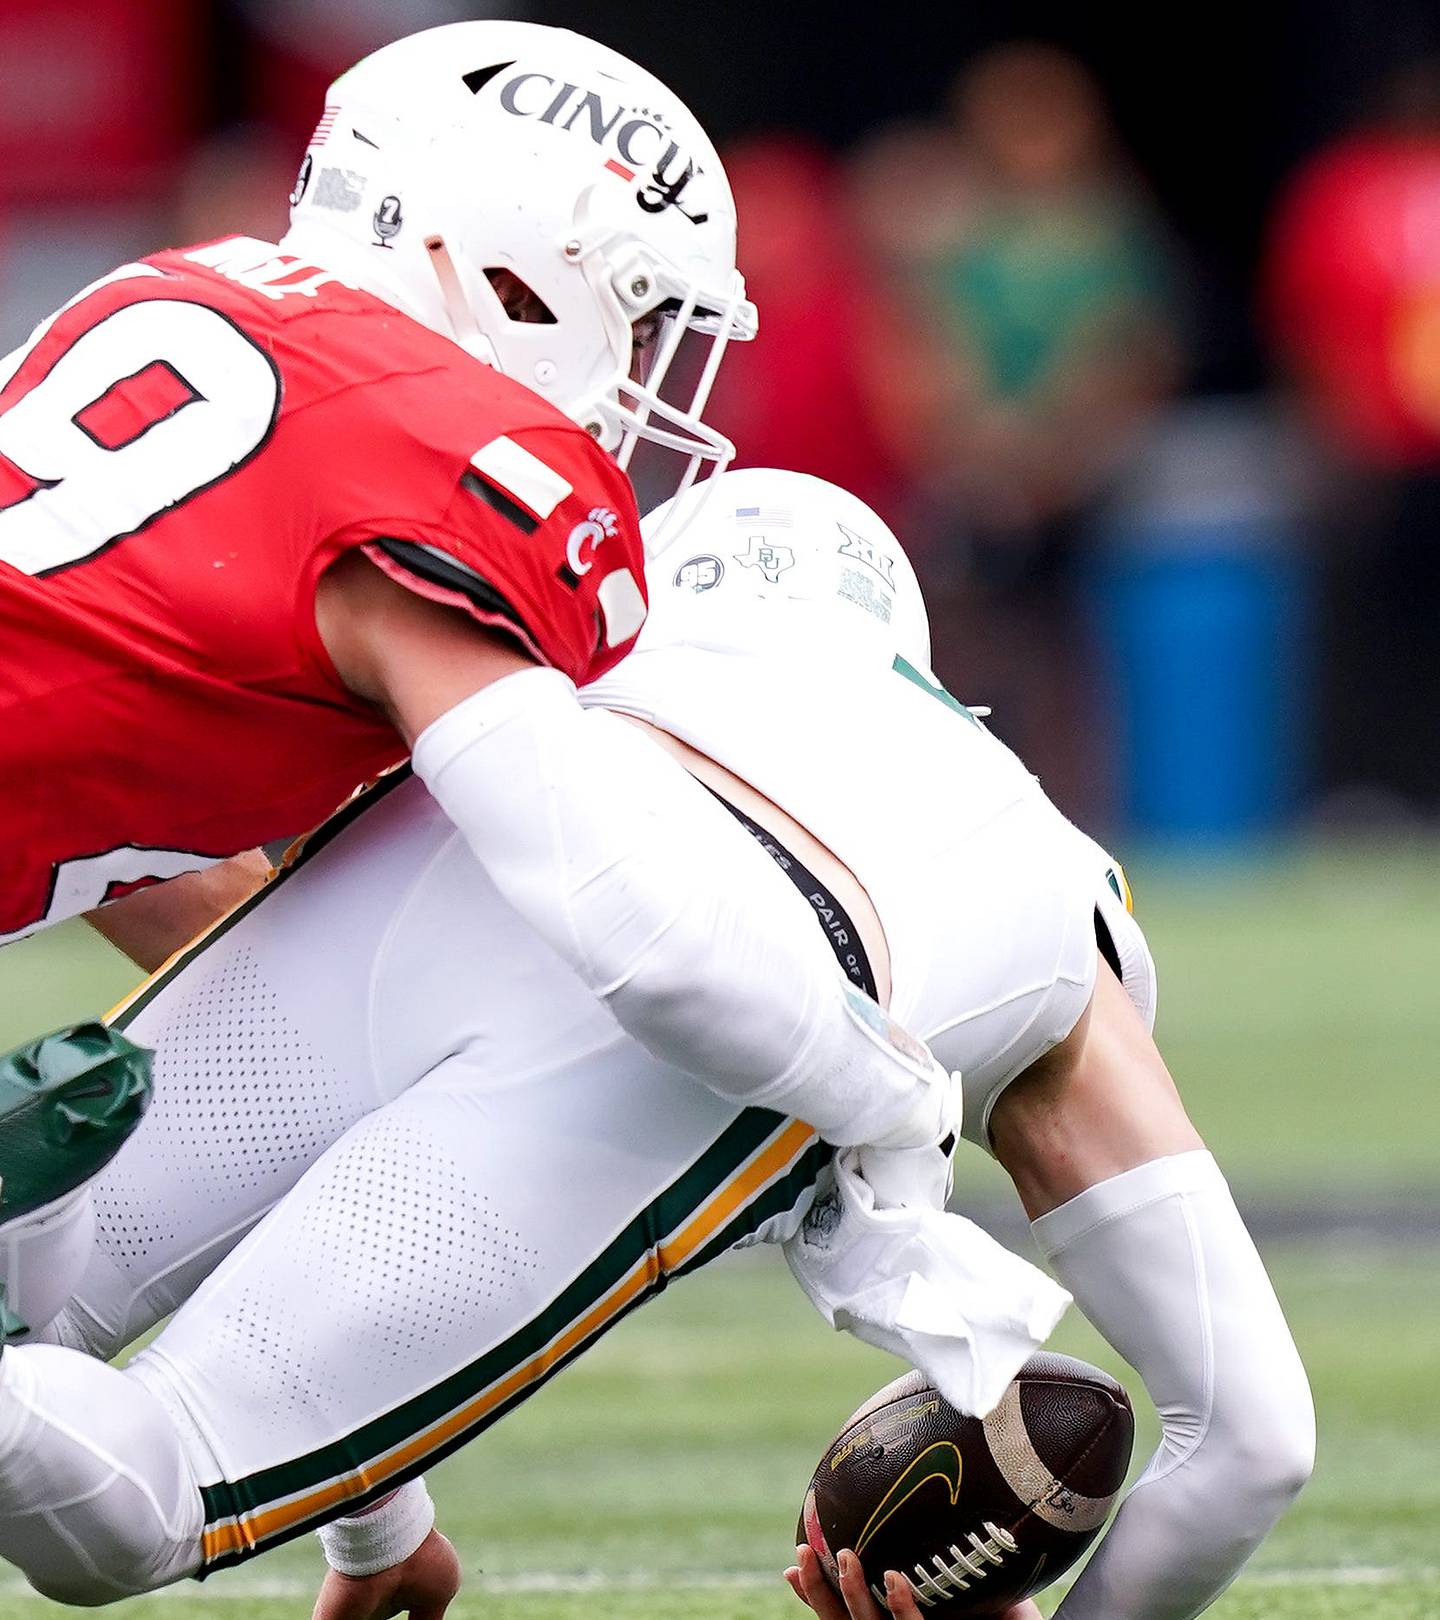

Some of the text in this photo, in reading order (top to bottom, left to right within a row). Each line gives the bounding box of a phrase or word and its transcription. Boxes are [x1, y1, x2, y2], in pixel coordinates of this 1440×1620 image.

[499, 72, 708, 225] CINCY
[809, 892, 862, 977] PAIR OF
